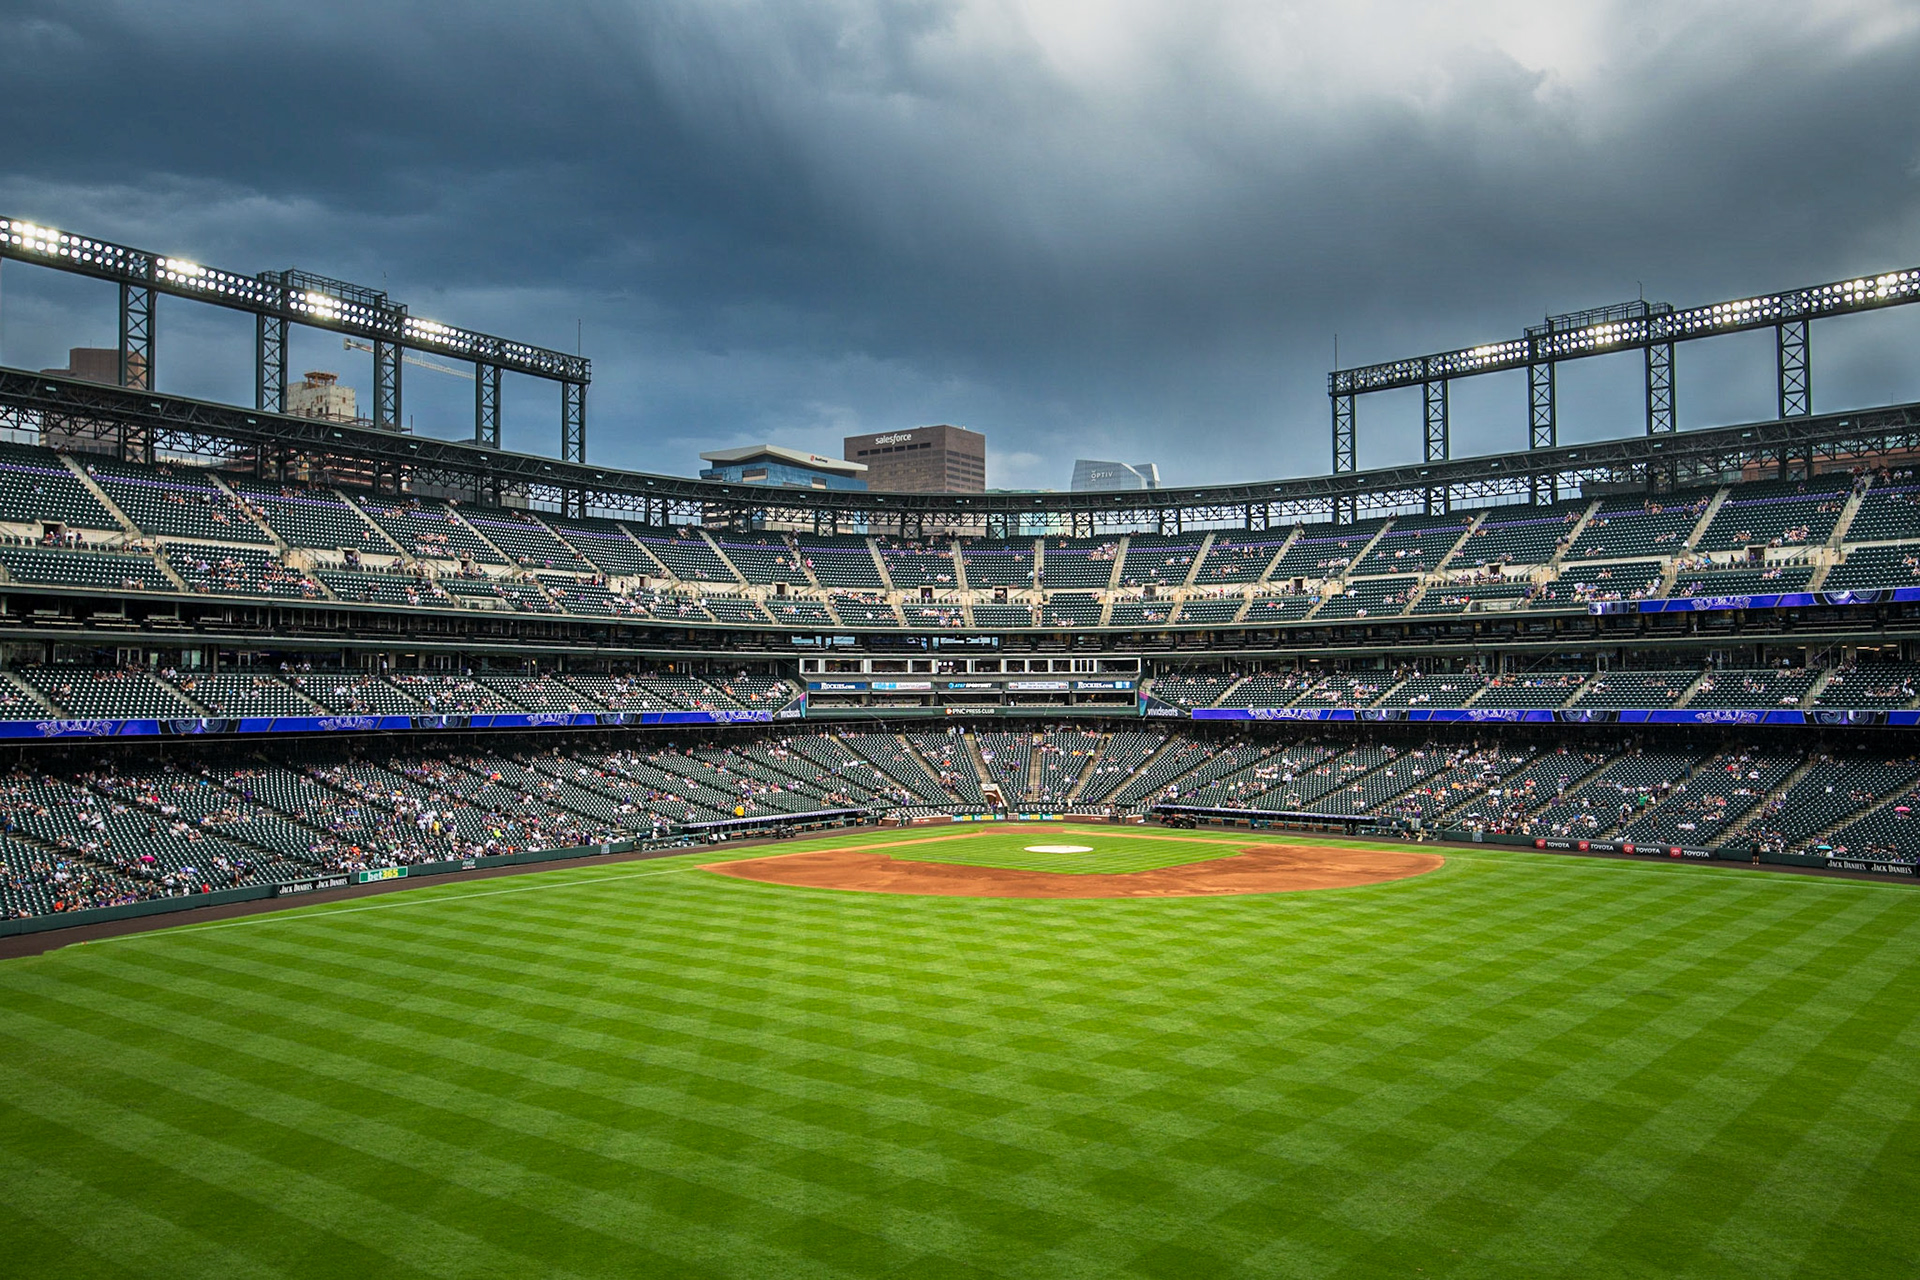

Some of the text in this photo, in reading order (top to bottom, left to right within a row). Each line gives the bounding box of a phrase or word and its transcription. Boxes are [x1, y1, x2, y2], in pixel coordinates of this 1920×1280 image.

[875, 433, 912, 445] salesforce
[1091, 470, 1114, 480] OPTIV
[1691, 596, 1752, 611] ROCKIES
[36, 719, 113, 738] ROCKIES
[1546, 841, 1570, 849] TOYOTA
[1590, 843, 1614, 851] TOYOTA
[1682, 850, 1710, 858] TOYOTA
[1827, 859, 1843, 868] JACK
[1871, 863, 1887, 872] JACK
[367, 868, 398, 881] bet365
[316, 880, 329, 889] JACK
[279, 886, 293, 894] JACK
